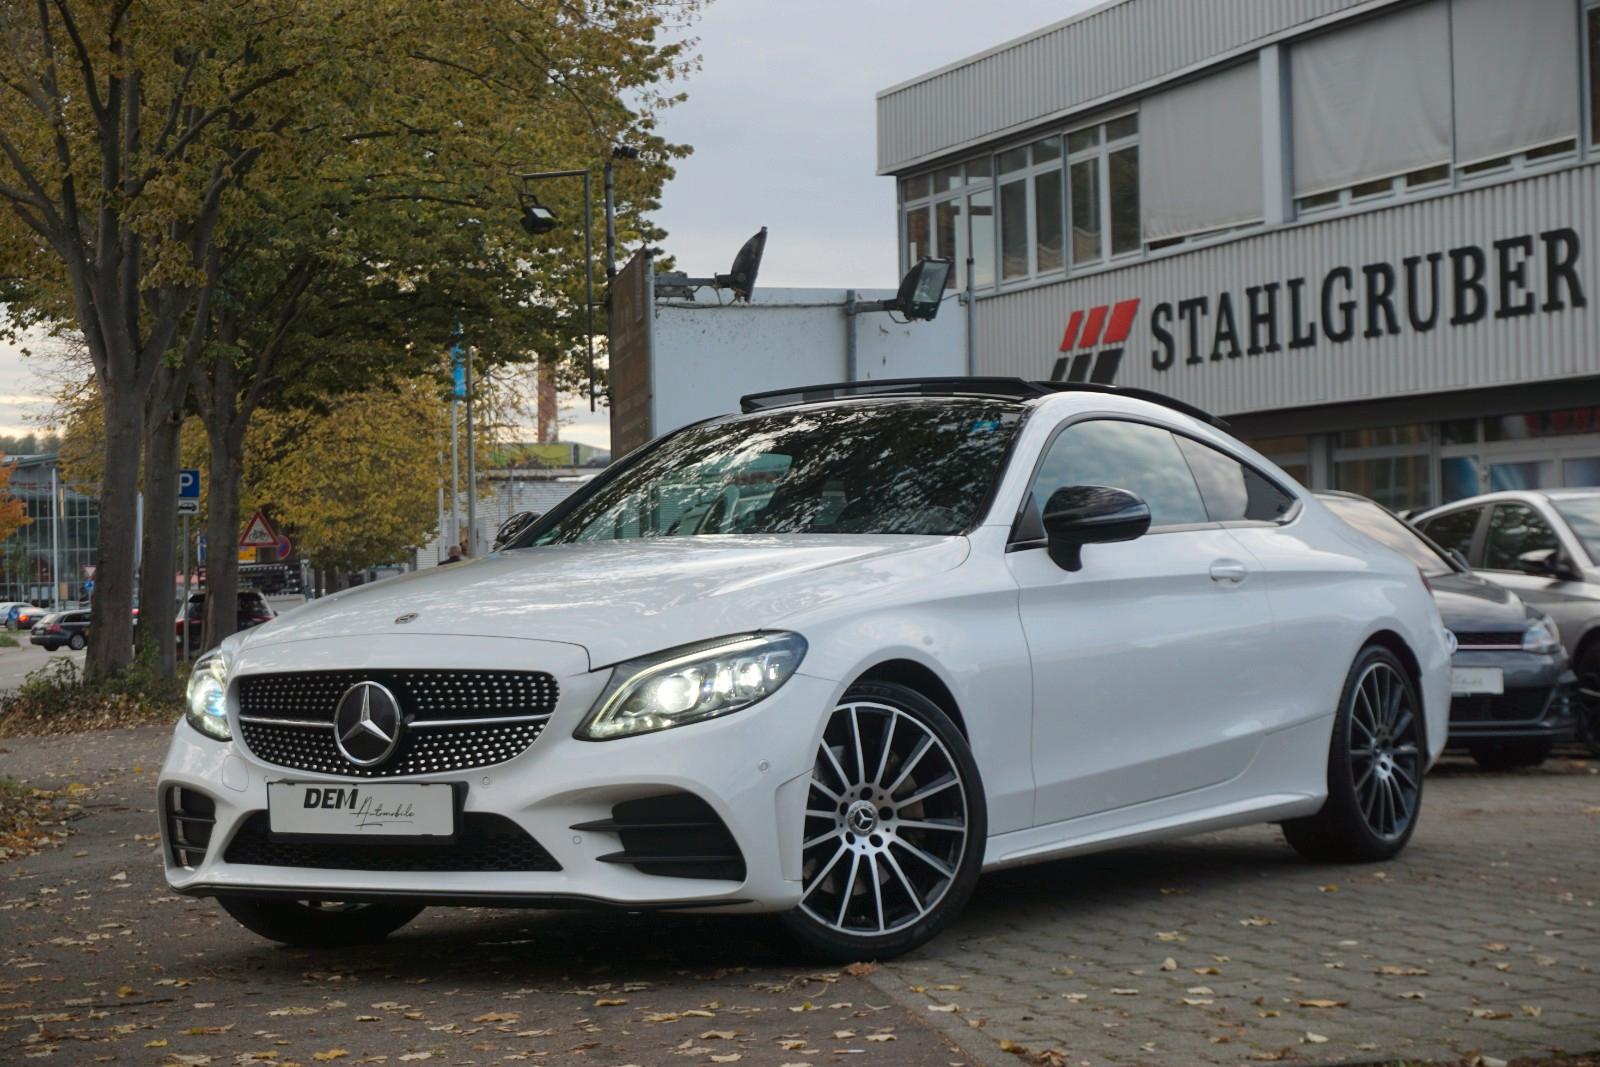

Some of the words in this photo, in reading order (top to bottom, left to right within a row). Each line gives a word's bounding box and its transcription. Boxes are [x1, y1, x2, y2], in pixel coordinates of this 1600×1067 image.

[1151, 228, 1586, 371] STAHLGRUBER
[178, 474, 193, 494] P
[303, 788, 359, 809] DEM
[350, 797, 415, 830] Automobile
